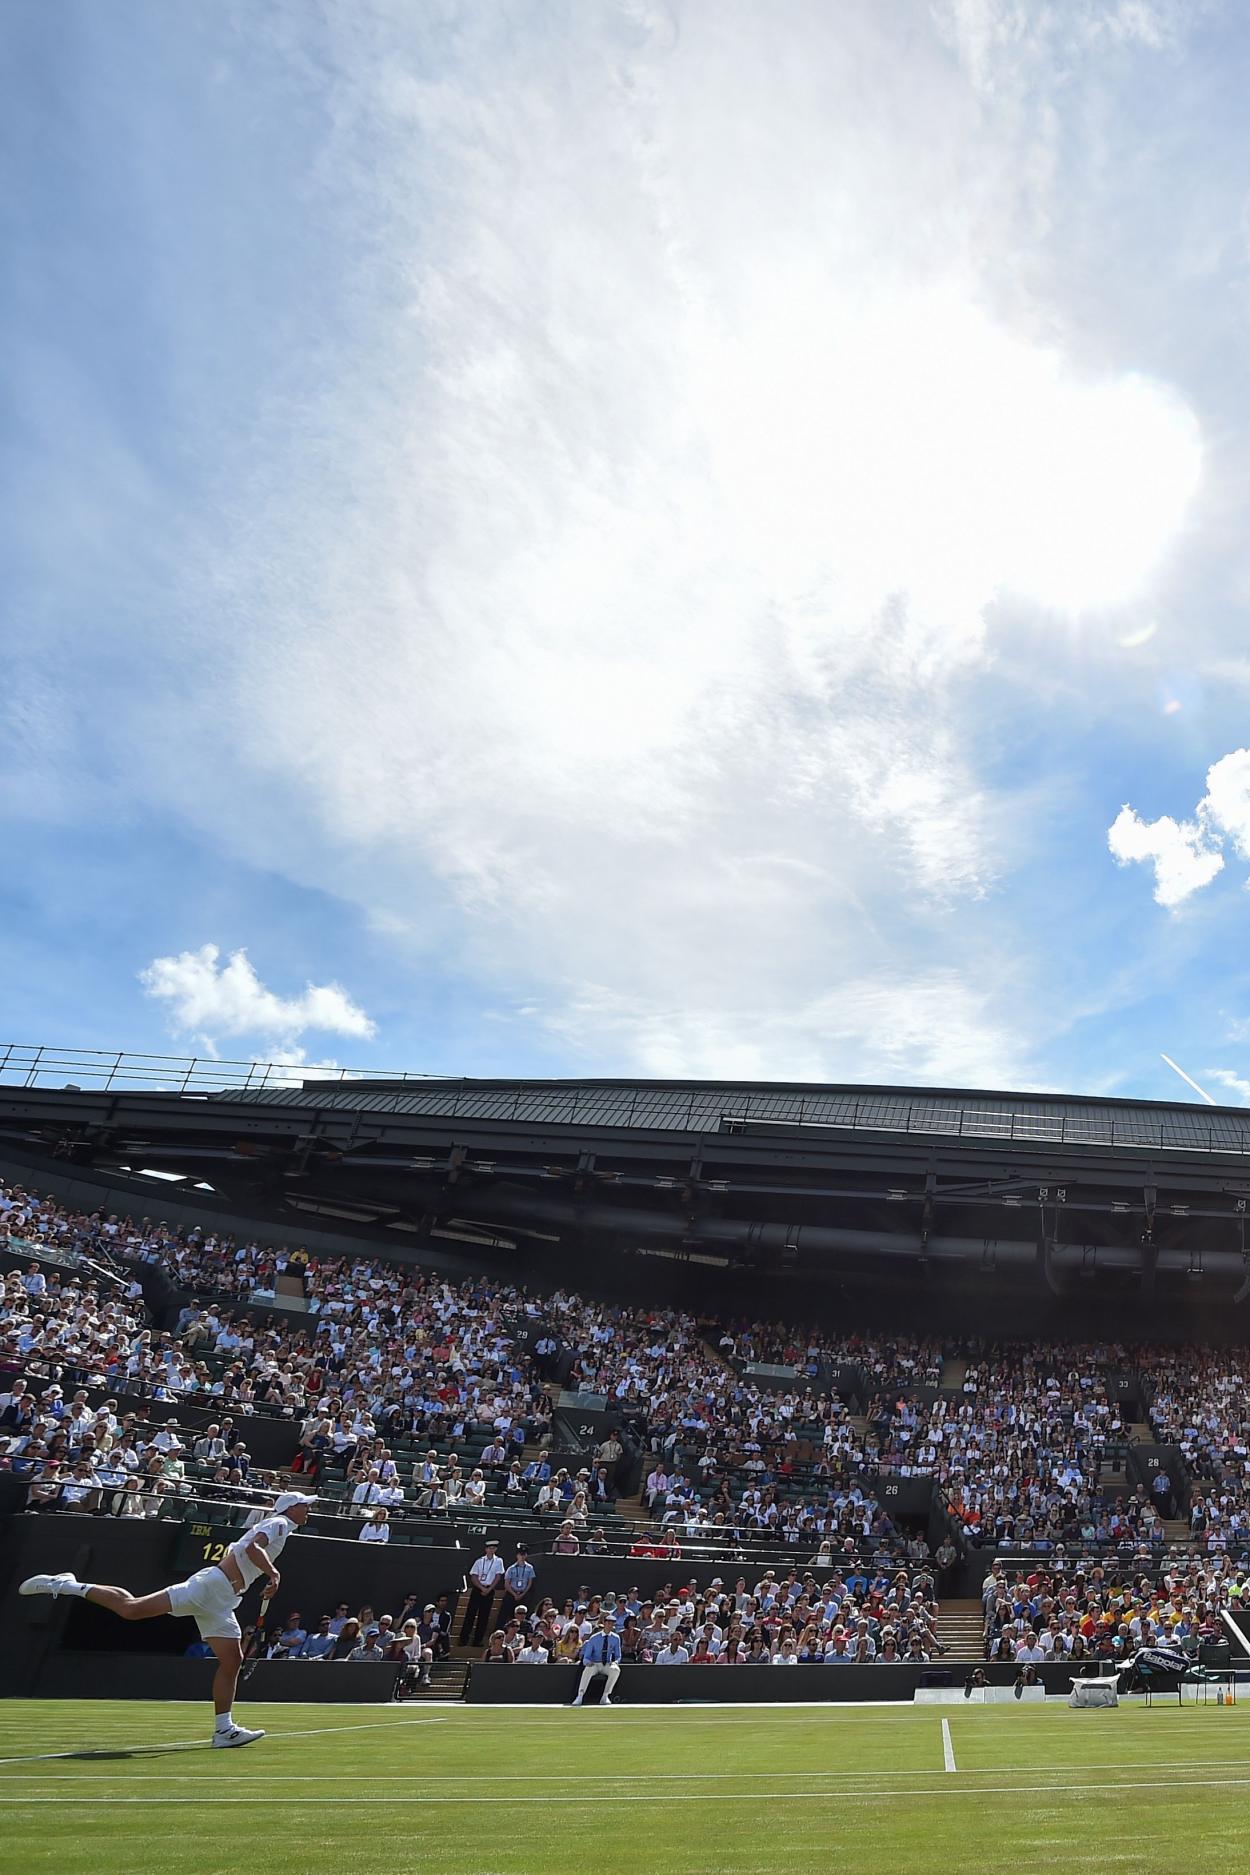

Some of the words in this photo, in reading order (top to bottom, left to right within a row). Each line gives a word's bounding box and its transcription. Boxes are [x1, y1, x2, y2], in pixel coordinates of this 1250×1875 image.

[517, 1330, 528, 1339] 29
[831, 1370, 841, 1378] 31
[1119, 1380, 1129, 1388] 33
[579, 1425, 594, 1436] 24
[1147, 1458, 1159, 1467] 28
[885, 1485, 898, 1495] 26
[190, 1525, 212, 1536] IBM
[1142, 1652, 1186, 1671] Babolat
